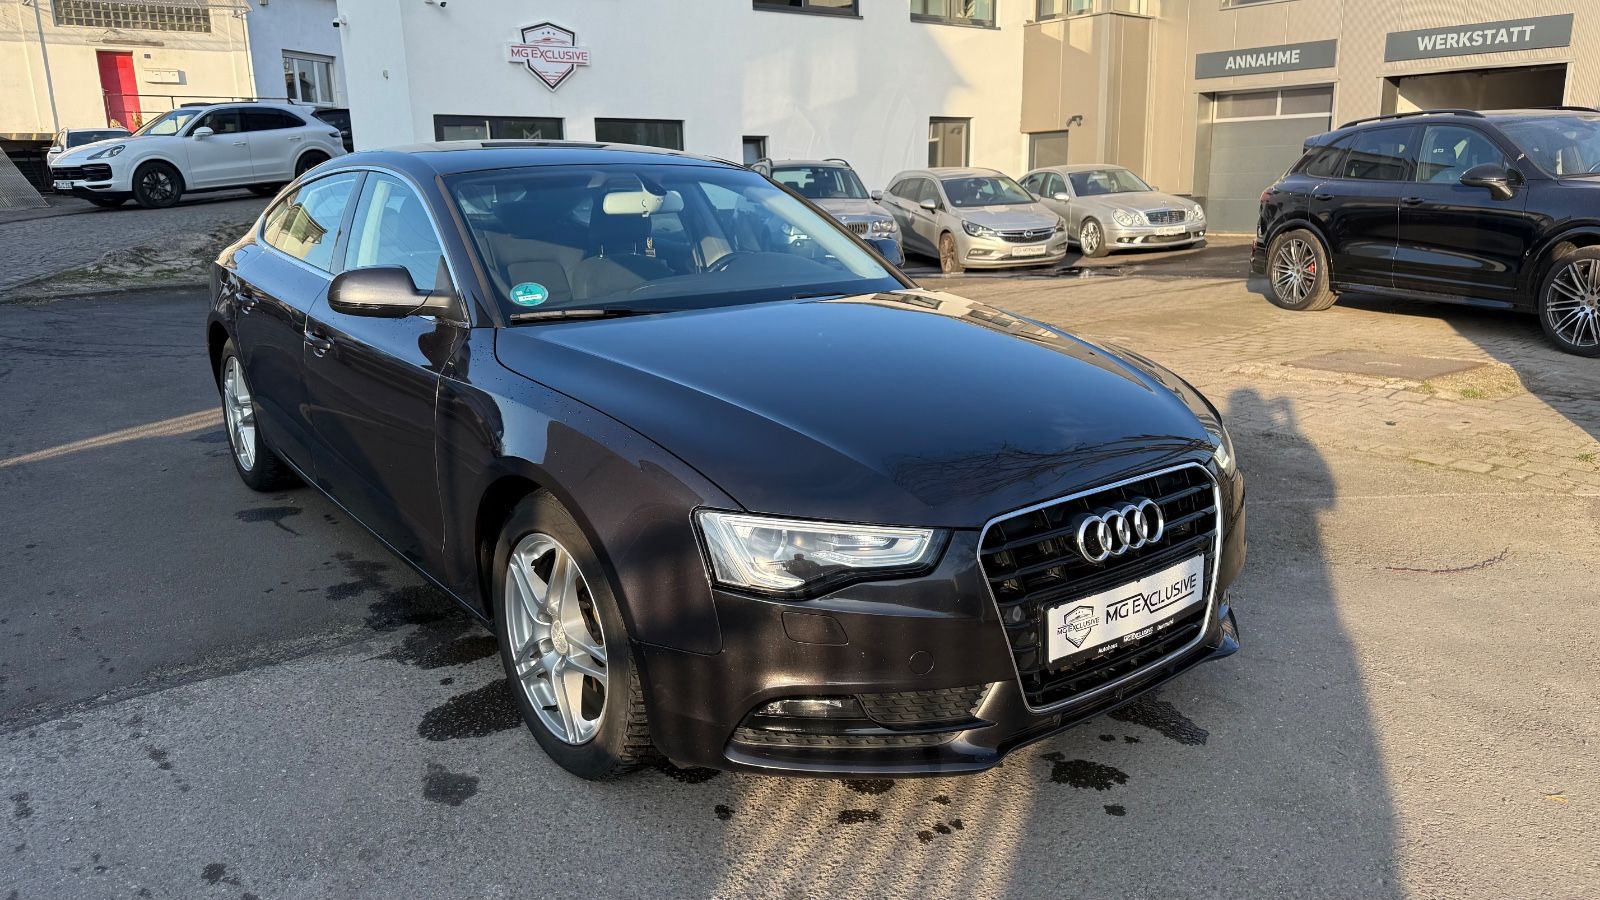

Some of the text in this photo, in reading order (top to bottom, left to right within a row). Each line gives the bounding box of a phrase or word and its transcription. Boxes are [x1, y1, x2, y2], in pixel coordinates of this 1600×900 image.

[1417, 25, 1535, 51] WERKSTATT
[511, 49, 588, 61] MG EXCLUSIVE
[1225, 49, 1300, 70] ANNAHME
[1106, 573, 1197, 625] MG EXCLUSIVE
[1068, 617, 1100, 632] EXCLUSIVE
